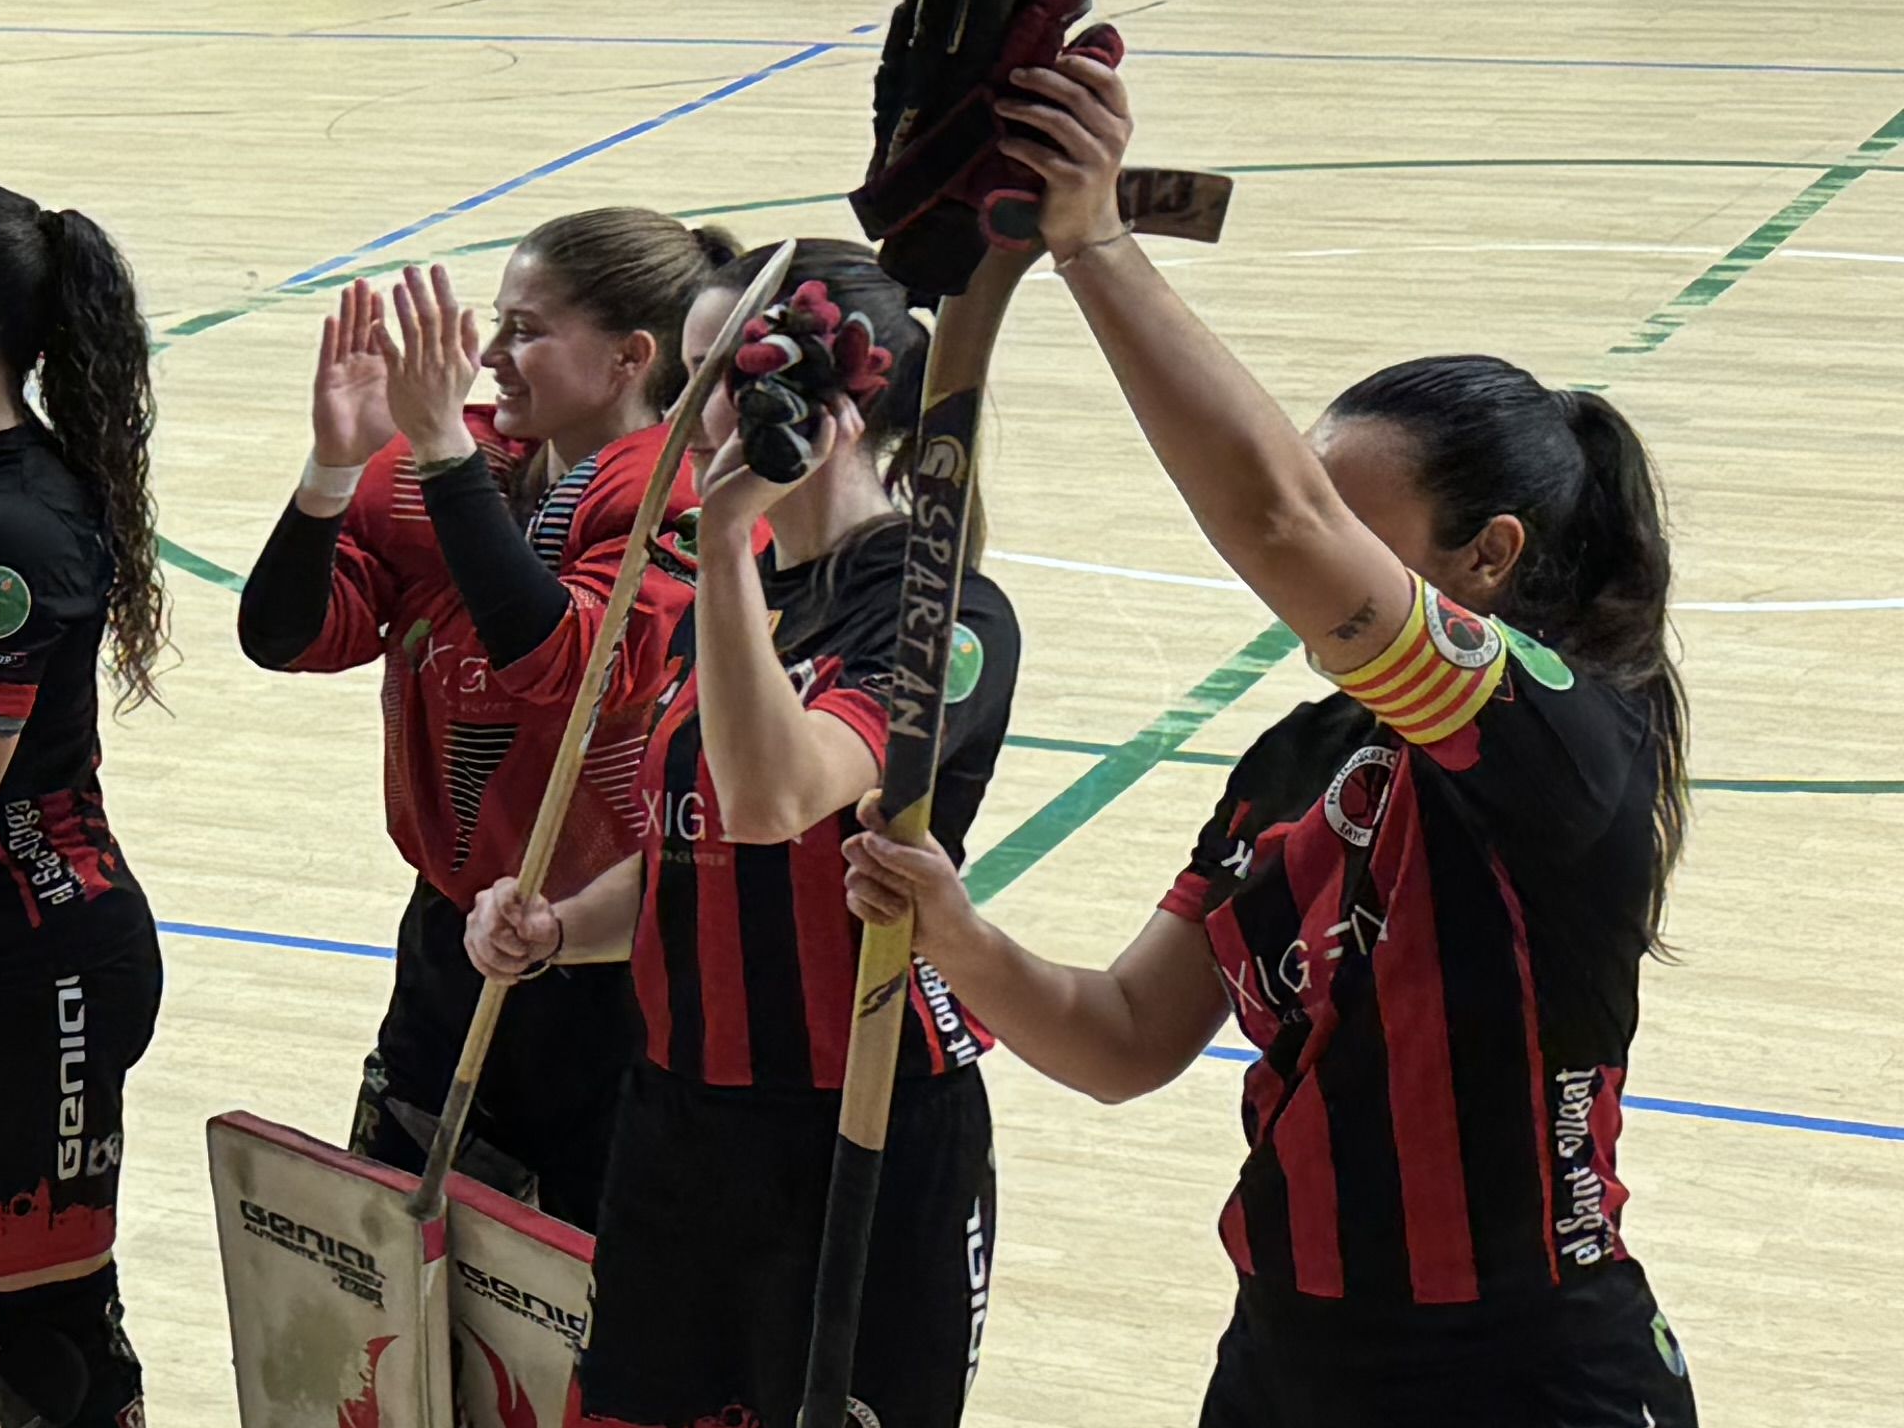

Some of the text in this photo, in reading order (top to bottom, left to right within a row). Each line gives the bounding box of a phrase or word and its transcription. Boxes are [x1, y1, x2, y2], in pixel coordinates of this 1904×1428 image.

[886, 494, 955, 740] SPARTAN
[1555, 1166, 1604, 1234] Sant
[1560, 1233, 1602, 1266] el
